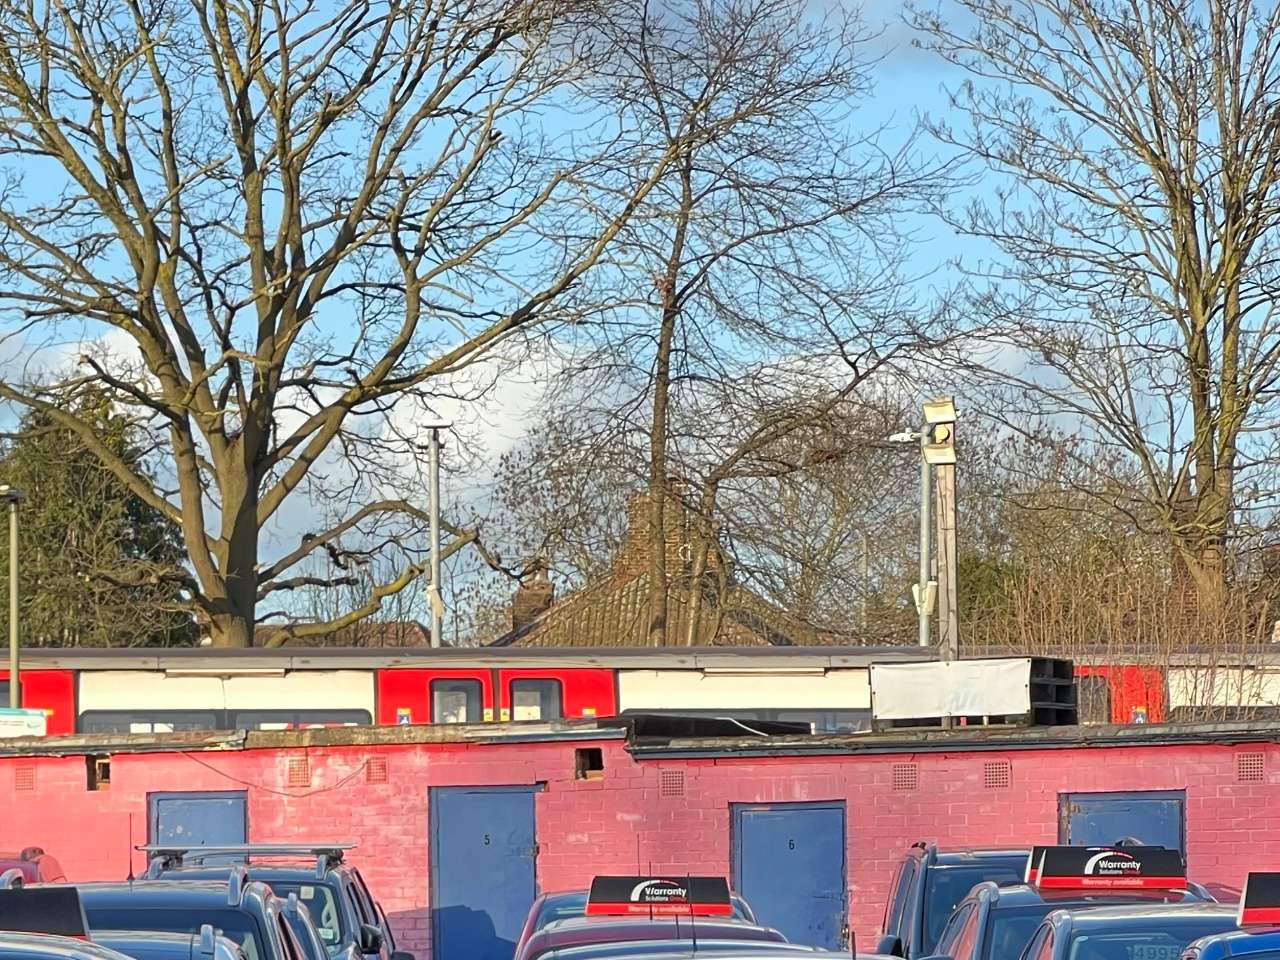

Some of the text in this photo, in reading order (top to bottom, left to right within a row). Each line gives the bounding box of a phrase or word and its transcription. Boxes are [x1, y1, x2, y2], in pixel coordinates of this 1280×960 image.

[484, 834, 490, 846] 5
[789, 839, 795, 850] 6
[1099, 860, 1141, 871] Warranty
[645, 887, 687, 898] Warranty
